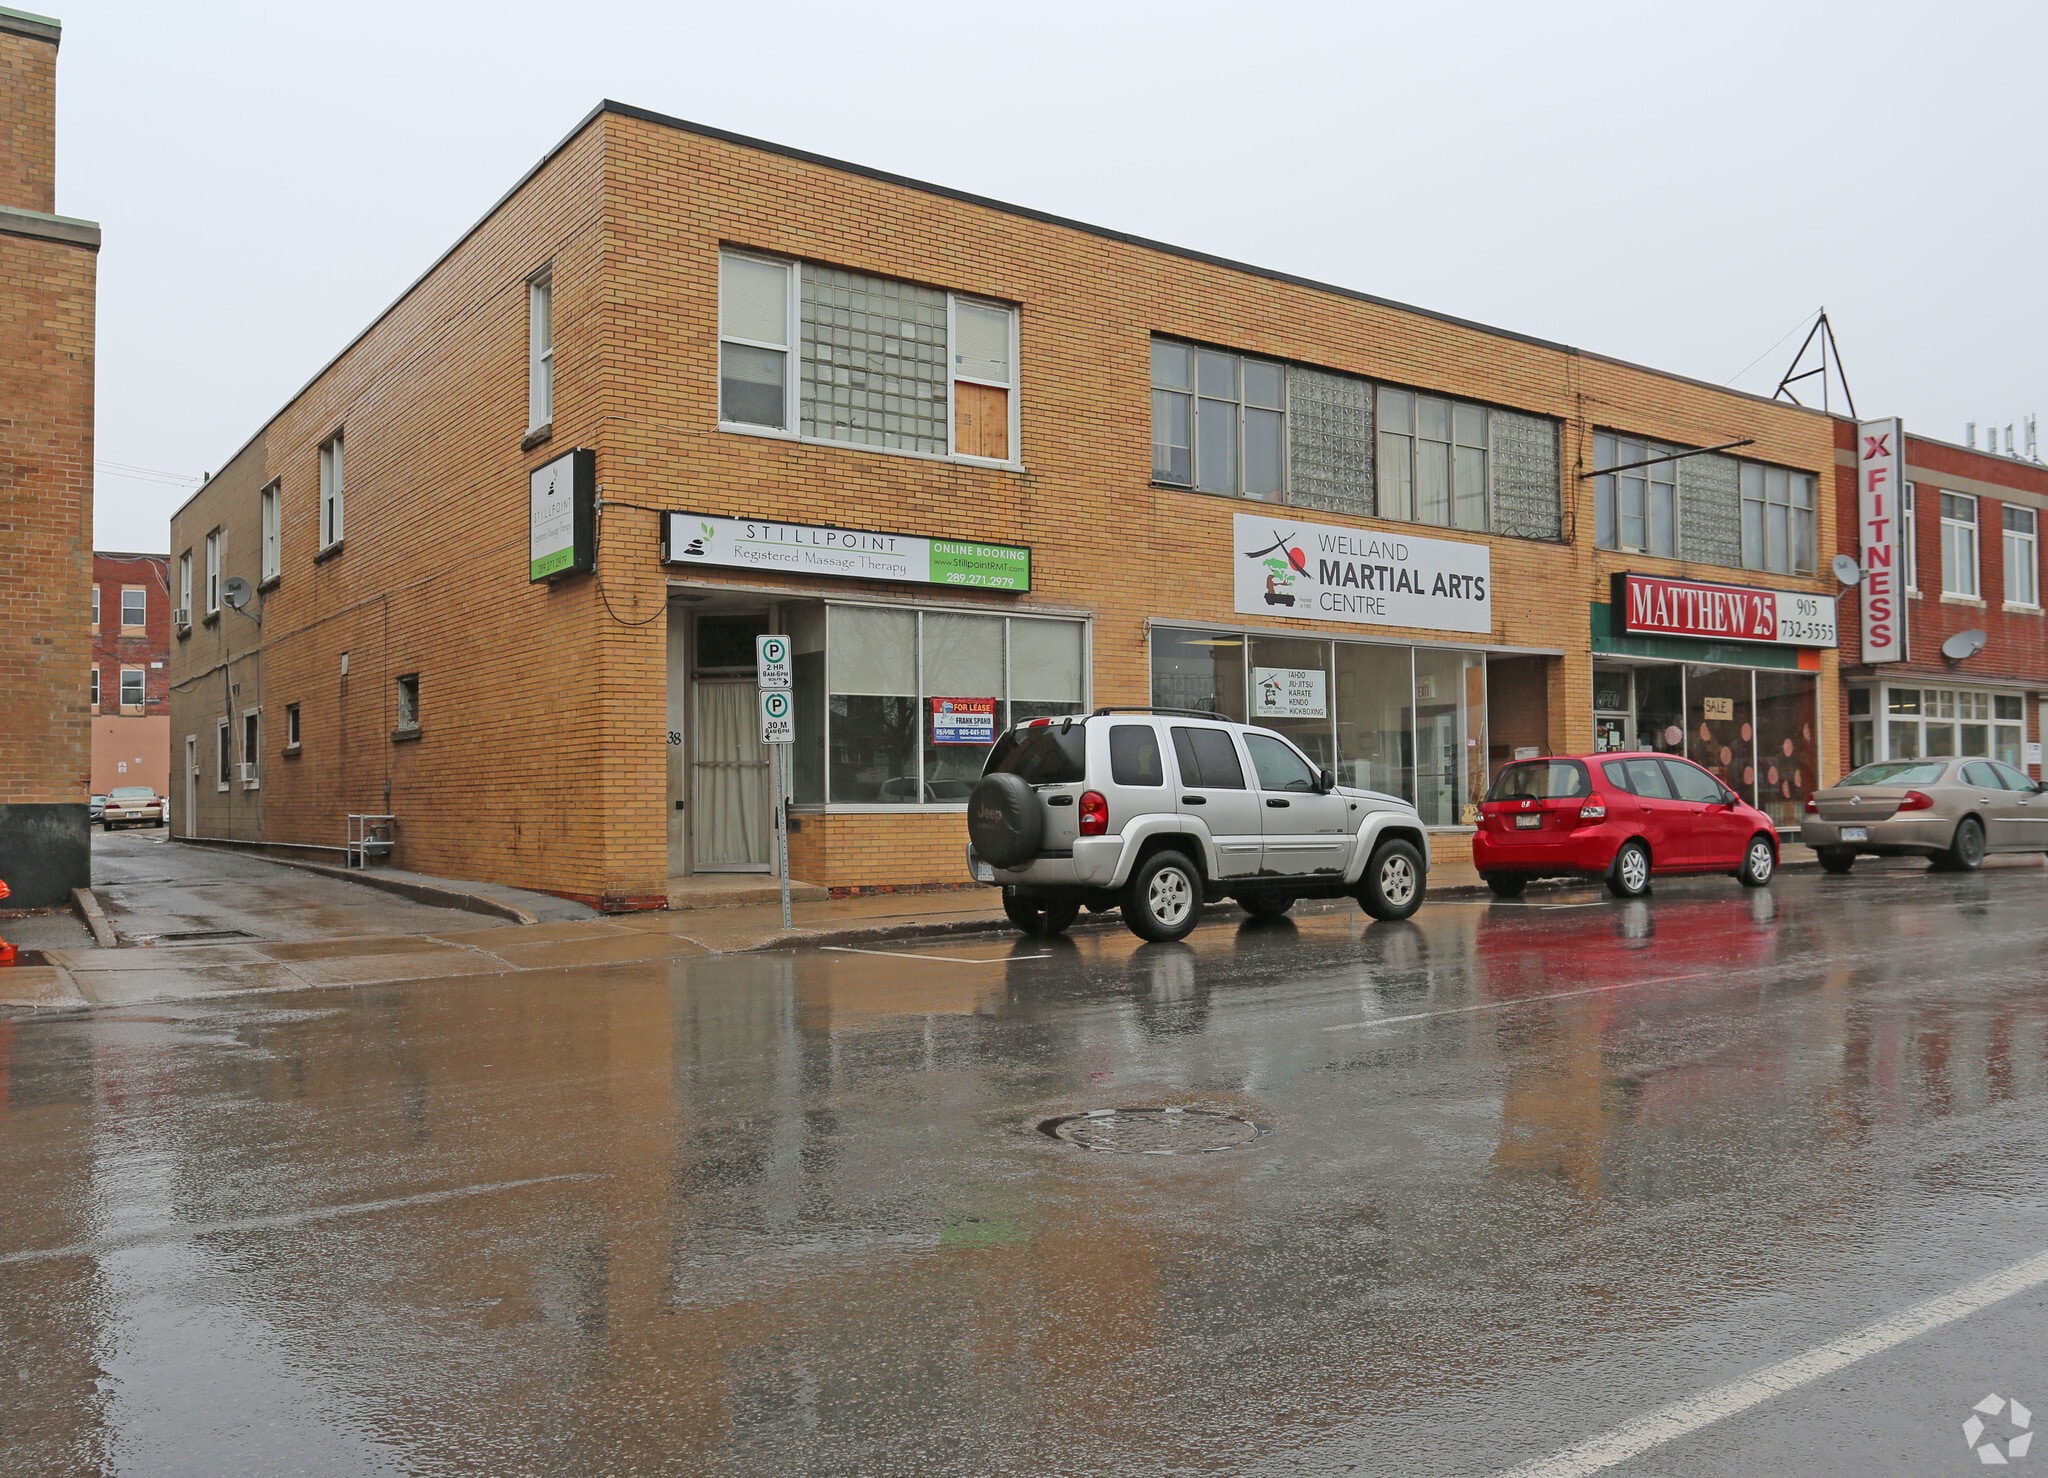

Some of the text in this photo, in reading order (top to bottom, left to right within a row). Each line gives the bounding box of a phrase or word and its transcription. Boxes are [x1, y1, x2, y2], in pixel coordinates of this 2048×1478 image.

[1863, 433, 1892, 461] X
[534, 497, 572, 523] STILLPOINT
[746, 524, 896, 552] STILLPOINT
[934, 543, 1025, 560] ONLINE BOOKING
[1318, 533, 1409, 562] WELLAND
[734, 545, 907, 576] Registered Massage Therapy
[934, 558, 1025, 573] www.StillpointRMT.com
[1867, 467, 1893, 648] FITNESS
[946, 572, 1015, 587] 289.271.2979
[1319, 559, 1486, 602] MARTIAL ARTS
[1319, 592, 1386, 615] CENTRE
[1630, 582, 1774, 636] MATTHEW 25
[1796, 598, 1818, 617] 905
[1781, 619, 1834, 641] 732-5555
[1288, 689, 1312, 697] KARATE
[1417, 685, 1430, 698] EXIT
[953, 703, 991, 712] FOR LEASE
[1288, 698, 1309, 706] KENDO
[1596, 693, 1619, 708] OPEN
[1705, 700, 1728, 714] SALE
[1289, 708, 1324, 716] KICKBOXING
[1606, 722, 1615, 730] 42
[666, 731, 682, 746] 38
[977, 804, 1003, 822] Jeep
